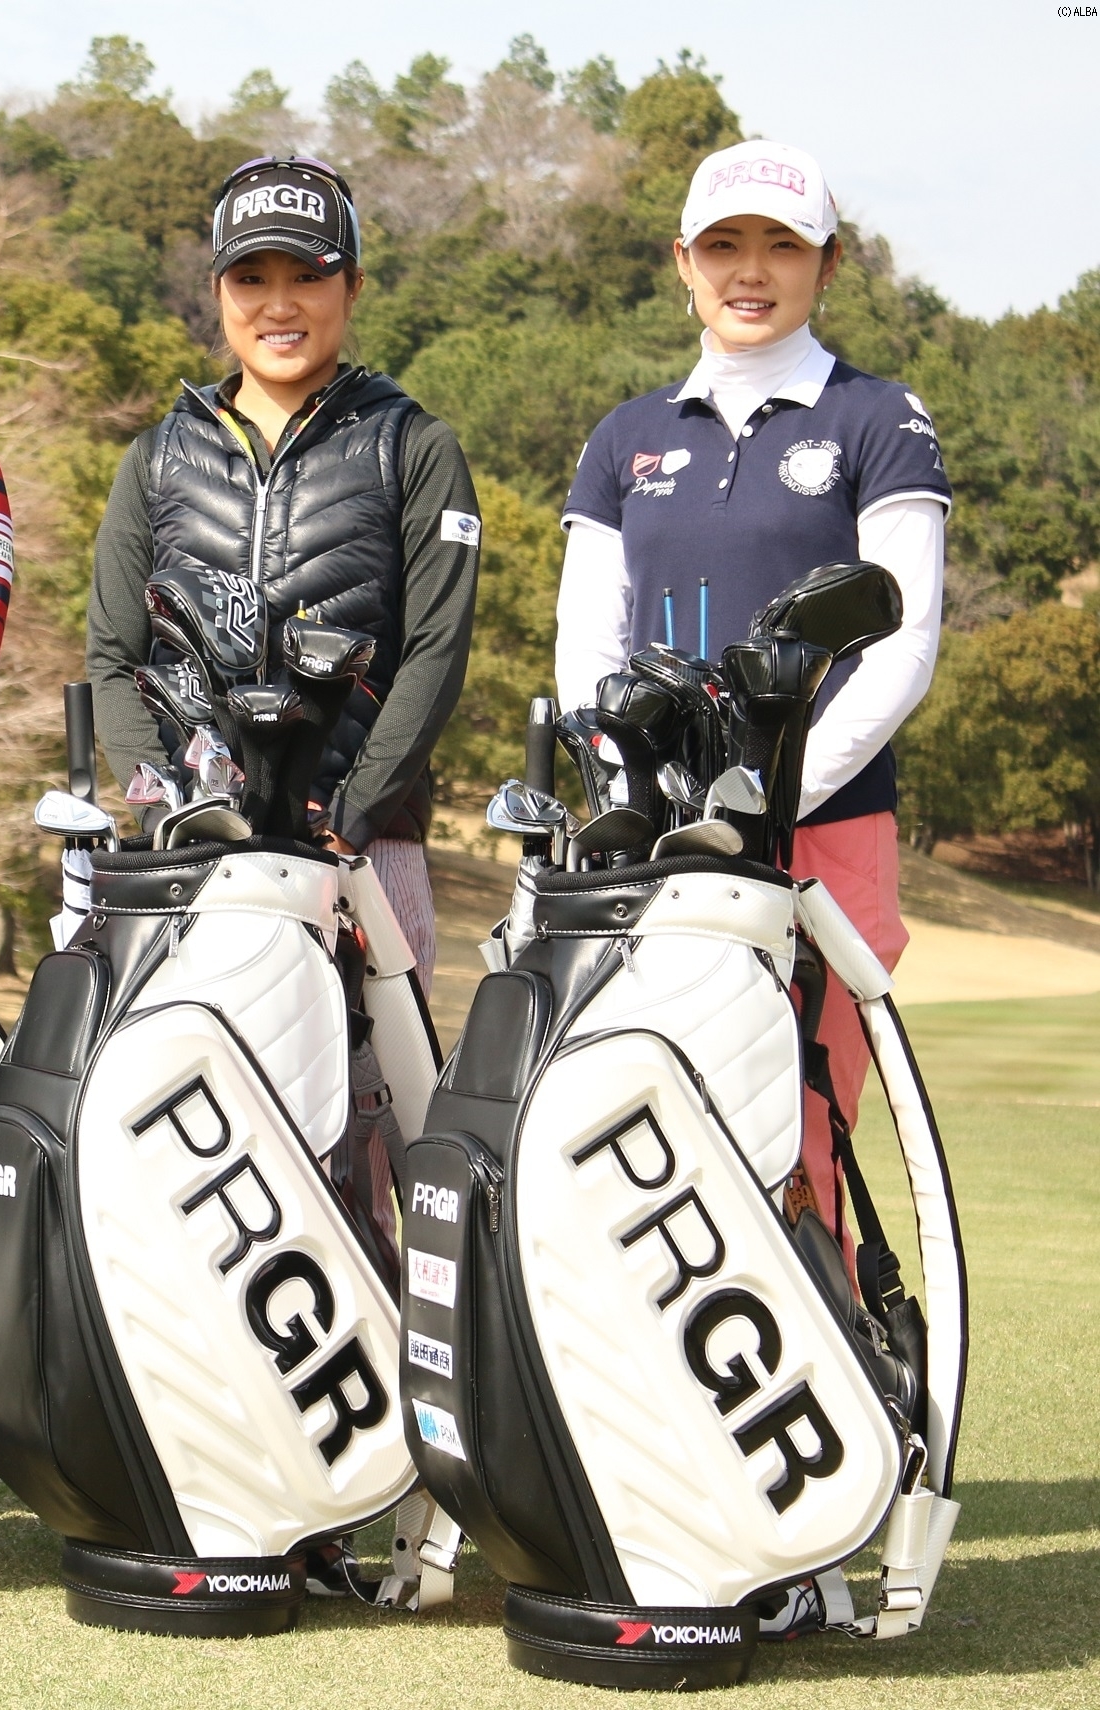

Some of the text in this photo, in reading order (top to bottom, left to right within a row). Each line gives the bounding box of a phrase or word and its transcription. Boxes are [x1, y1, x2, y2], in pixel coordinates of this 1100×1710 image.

[708, 159, 806, 197] PRGR
[231, 183, 326, 236] PRGR
[217, 568, 259, 654] RS
[299, 655, 333, 673] PRGR
[253, 713, 278, 722] PRGR
[411, 1181, 459, 1224] PRGR
[131, 1074, 390, 1467] PRGR
[572, 1103, 845, 1516] PRGR
[205, 1573, 291, 1593] YOKOHAMA
[651, 1625, 741, 1645] YOKOHAMA
